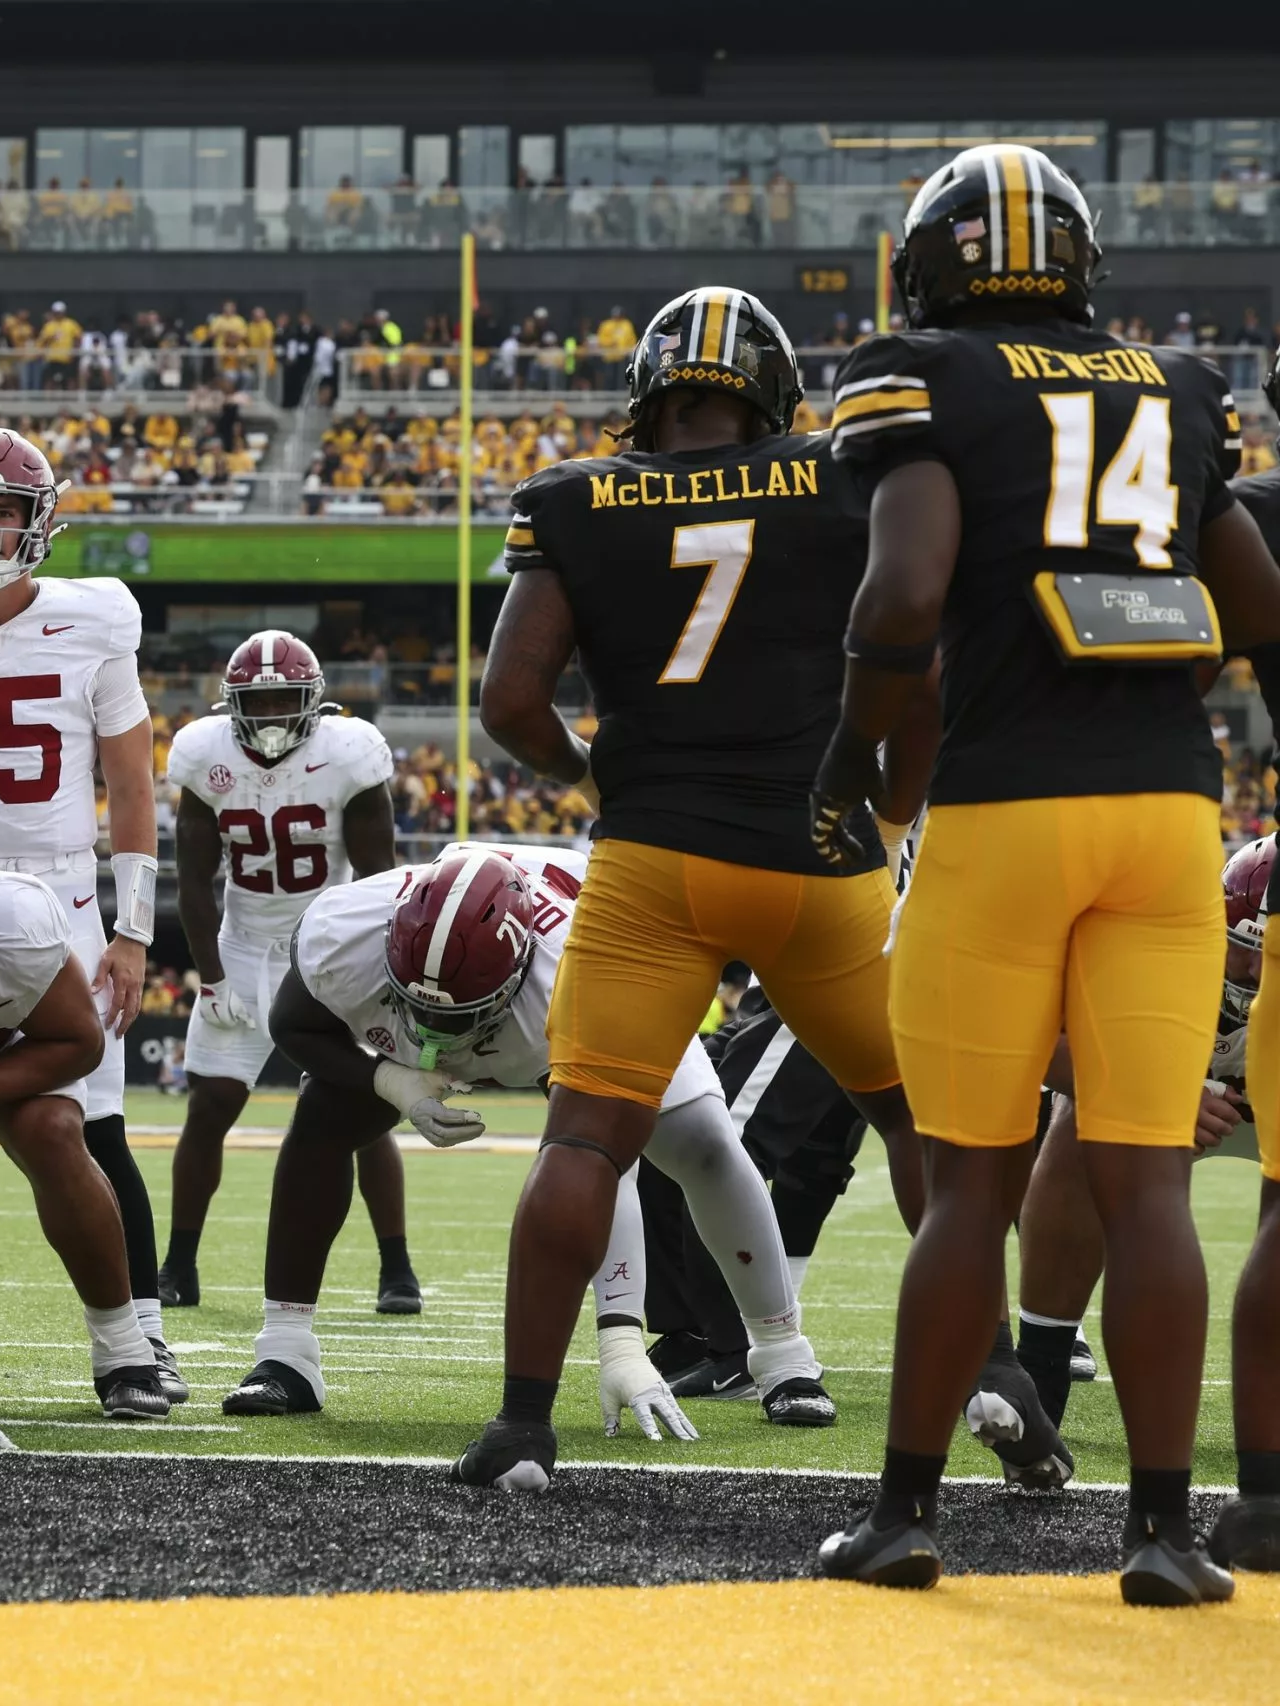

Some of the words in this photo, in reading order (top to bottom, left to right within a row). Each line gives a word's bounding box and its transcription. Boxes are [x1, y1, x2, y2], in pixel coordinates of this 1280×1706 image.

[801, 270, 848, 291] 129
[997, 343, 1167, 386] NEWSON
[589, 460, 818, 509] McCLELLAN
[1038, 391, 1179, 569] 14
[656, 519, 756, 684] 7
[1102, 589, 1150, 608] PRO
[209, 765, 231, 787] SEC
[219, 804, 328, 895] 26
